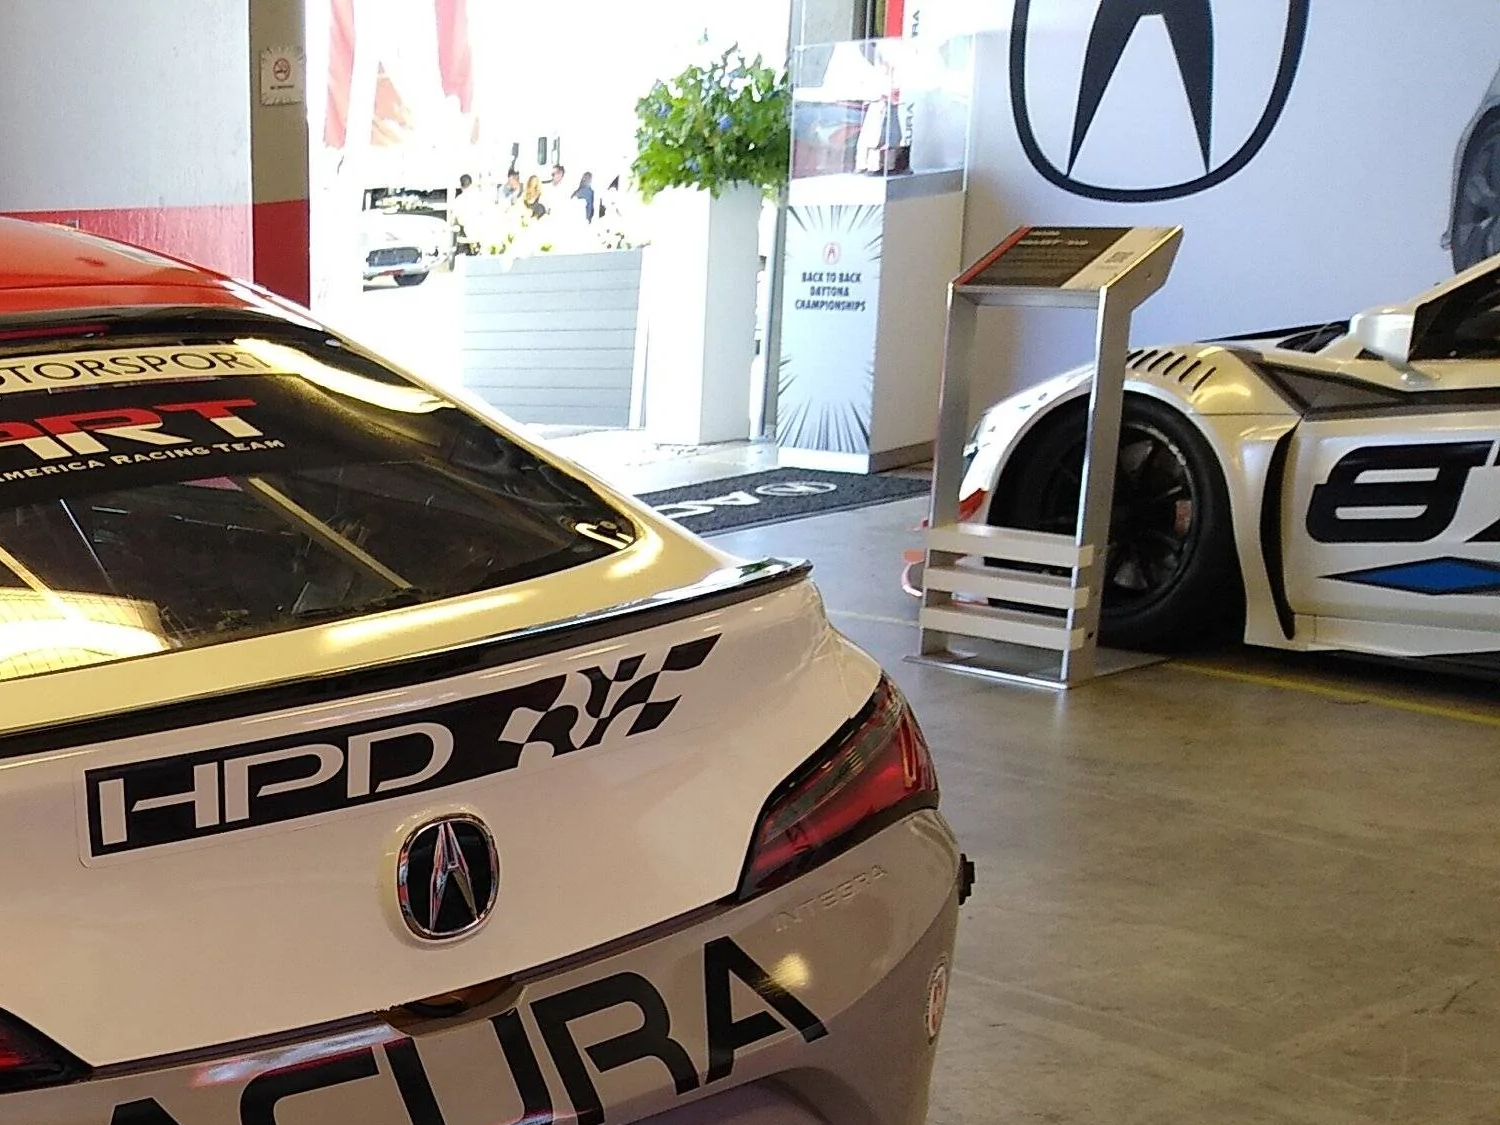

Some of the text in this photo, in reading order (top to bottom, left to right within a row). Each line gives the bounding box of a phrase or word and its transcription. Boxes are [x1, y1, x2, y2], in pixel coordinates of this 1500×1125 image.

[801, 272, 862, 283] BACK TO BACK
[810, 286, 850, 297] DAYTONA
[795, 299, 866, 312] CHAMPIONSHIPS
[111, 445, 209, 465] RACING
[211, 438, 285, 453] TEAM
[1306, 440, 1500, 543] 8
[98, 722, 455, 847] HPD
